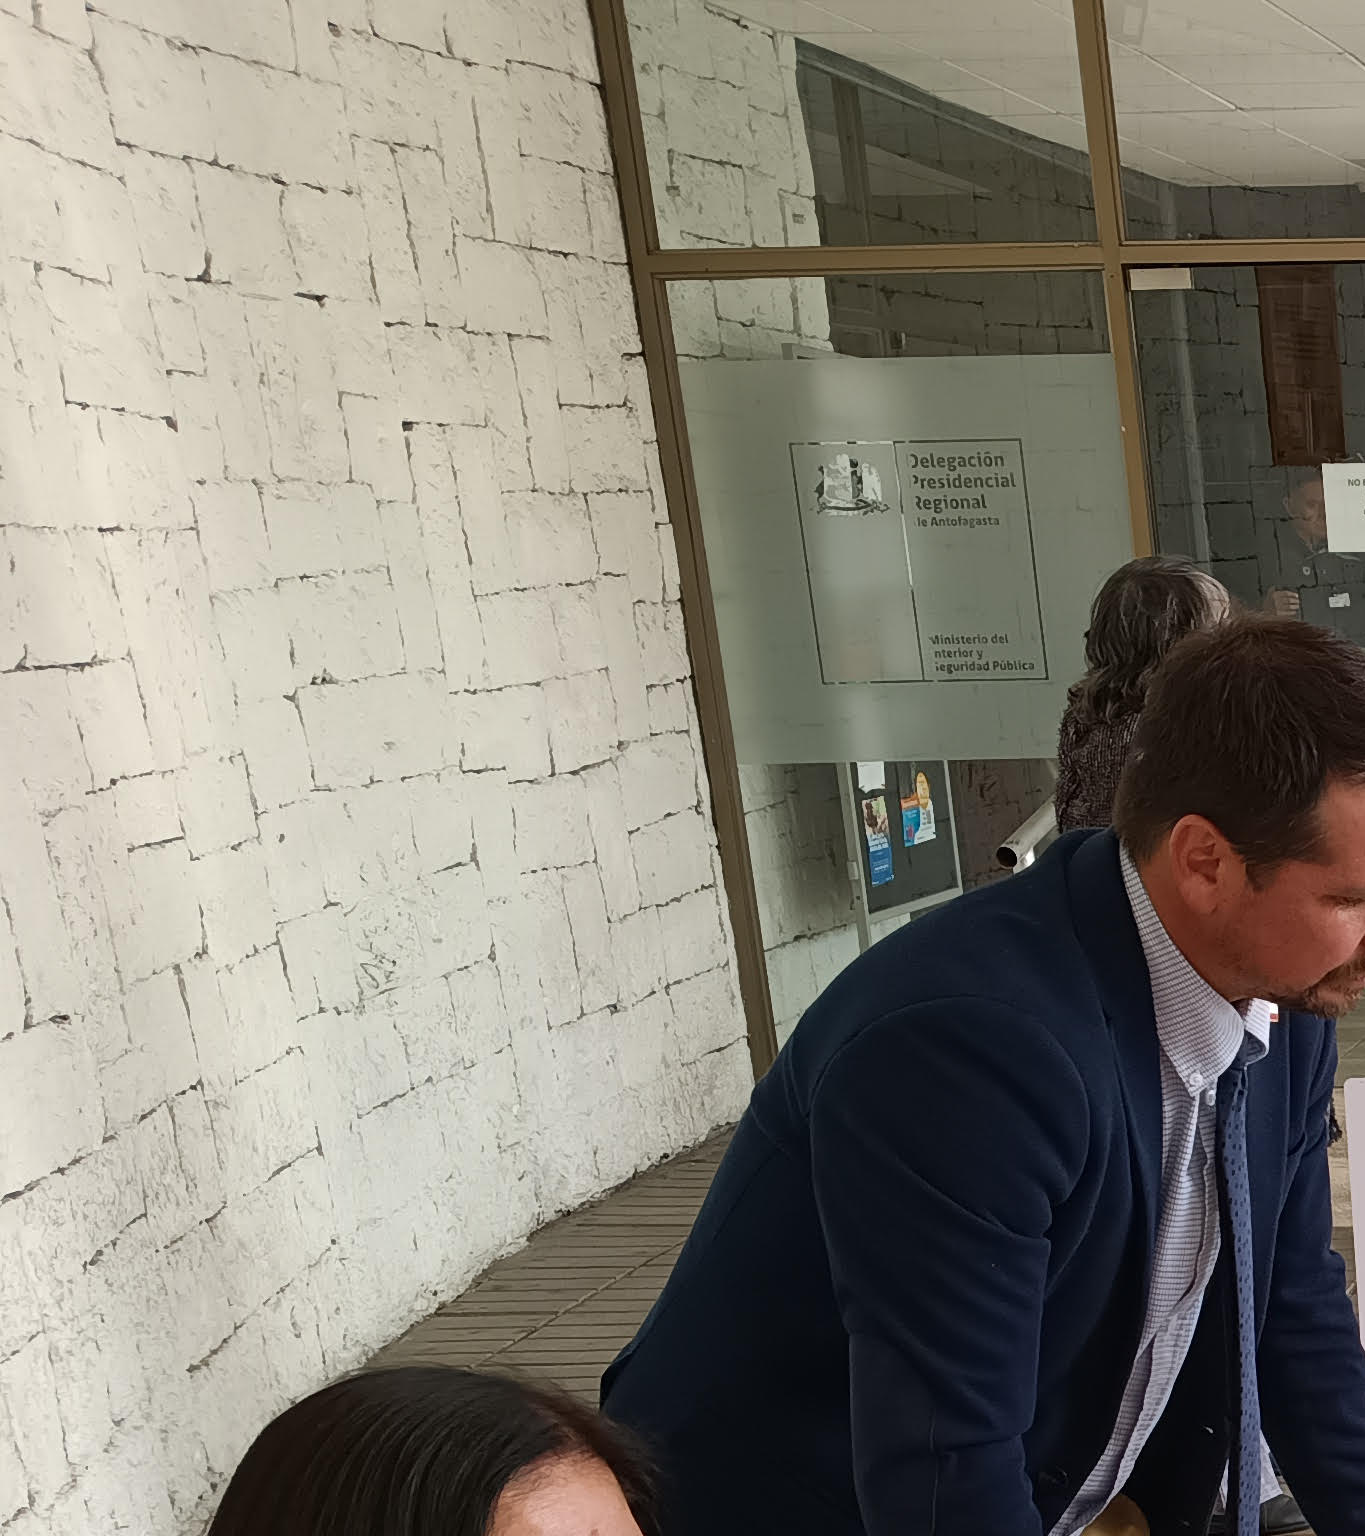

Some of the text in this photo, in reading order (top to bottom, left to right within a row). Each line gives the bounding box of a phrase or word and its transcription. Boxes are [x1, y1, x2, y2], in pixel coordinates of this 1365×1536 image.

[930, 516, 1000, 528] Antofagasta
[991, 633, 1008, 644] del
[935, 648, 983, 660] nterior y
[992, 660, 1035, 671] Pública
